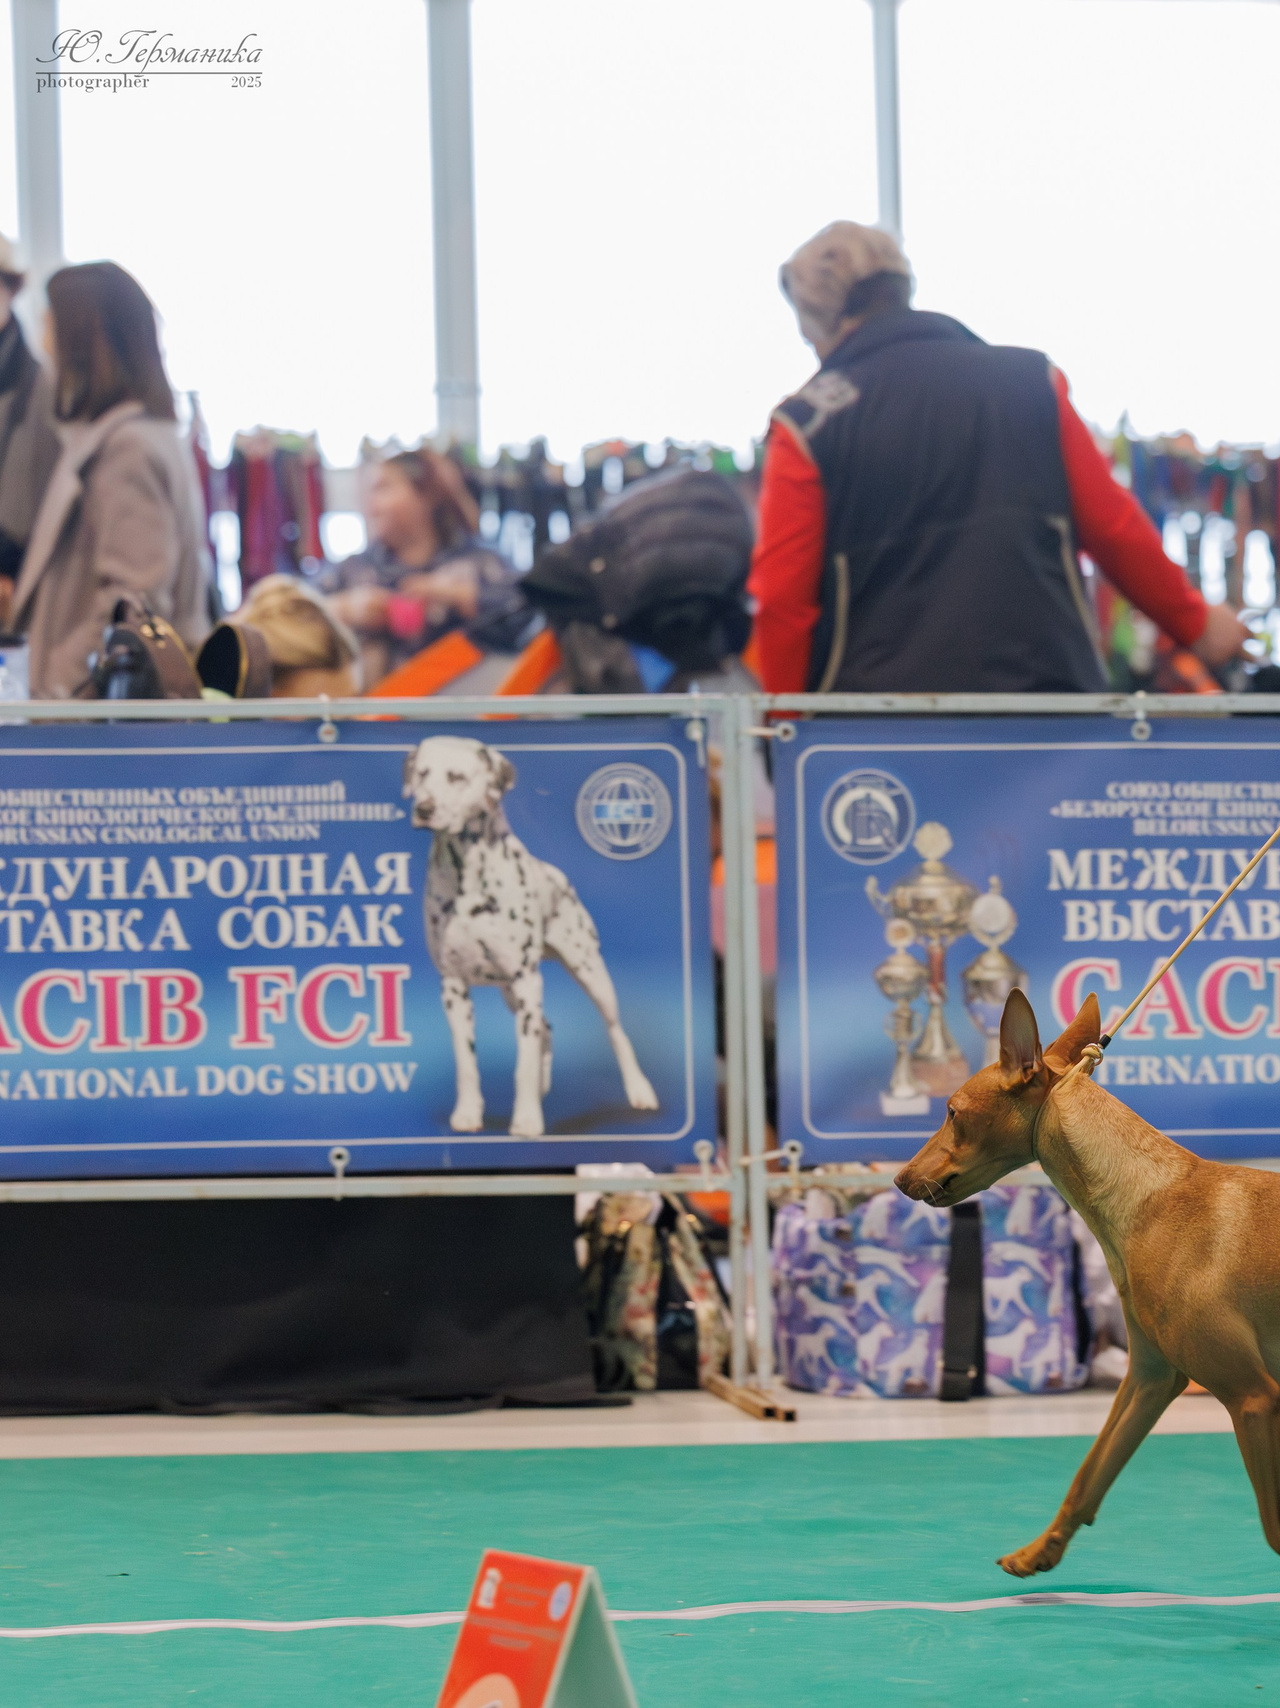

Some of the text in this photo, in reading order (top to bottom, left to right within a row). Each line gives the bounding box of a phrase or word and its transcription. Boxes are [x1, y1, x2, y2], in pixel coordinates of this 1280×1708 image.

[1105, 782, 1171, 800] СОЮЗ
[0, 823, 320, 845] RUSSIAN CINOLOGICAL UNION
[1133, 819, 1275, 837] BELORUSSIAN
[0, 852, 412, 908] ДУНАРОДНАЯ
[218, 904, 404, 950] СОБАК
[227, 963, 412, 1050] FCI
[195, 1064, 286, 1097] DOG
[293, 1062, 418, 1094] SHOW
